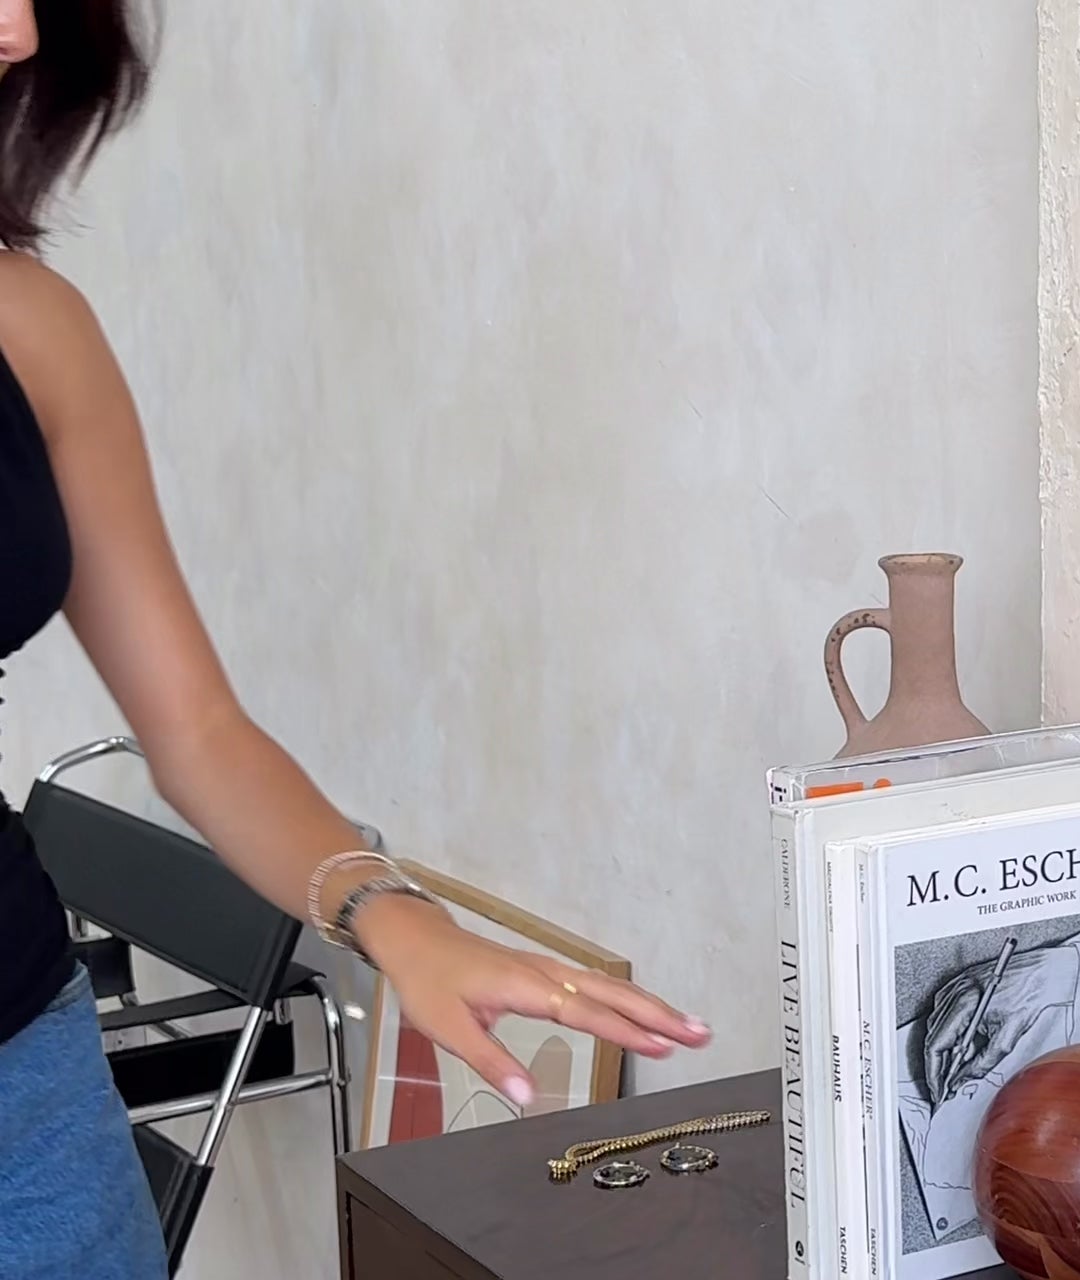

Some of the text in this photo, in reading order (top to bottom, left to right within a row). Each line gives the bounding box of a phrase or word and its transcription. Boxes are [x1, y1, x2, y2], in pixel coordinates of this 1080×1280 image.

[906, 864, 987, 907] M.C.
[977, 889, 1077, 916] THE GRAPHIC WORK
[781, 940, 805, 1208] LIVE BEAUTIFUL
[832, 1034, 842, 1103] BAUHAUS
[839, 1226, 847, 1274] TASCHEN
